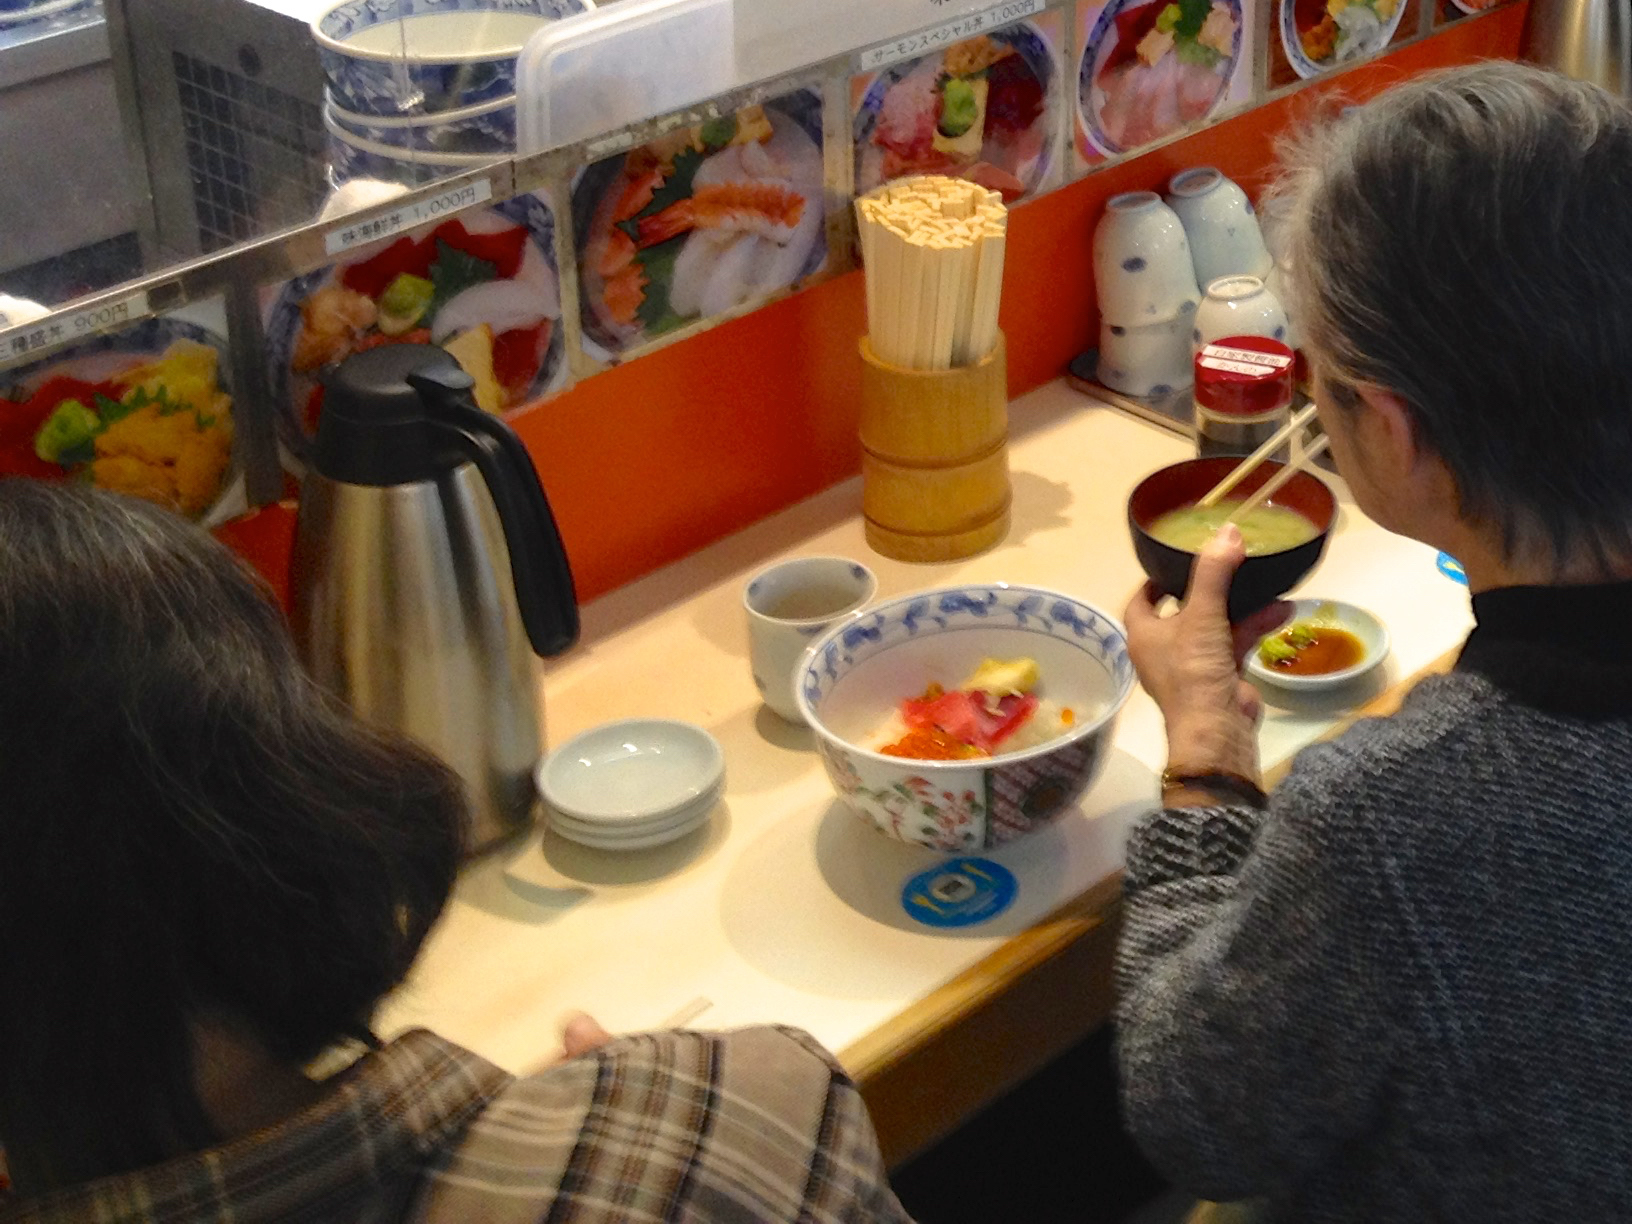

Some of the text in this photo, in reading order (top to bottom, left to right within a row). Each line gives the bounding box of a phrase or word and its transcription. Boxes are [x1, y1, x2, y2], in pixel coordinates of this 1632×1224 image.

[871, 15, 984, 64] サーモンスペシャル丼
[414, 186, 476, 219] 1,000円
[73, 301, 129, 332] 900円
